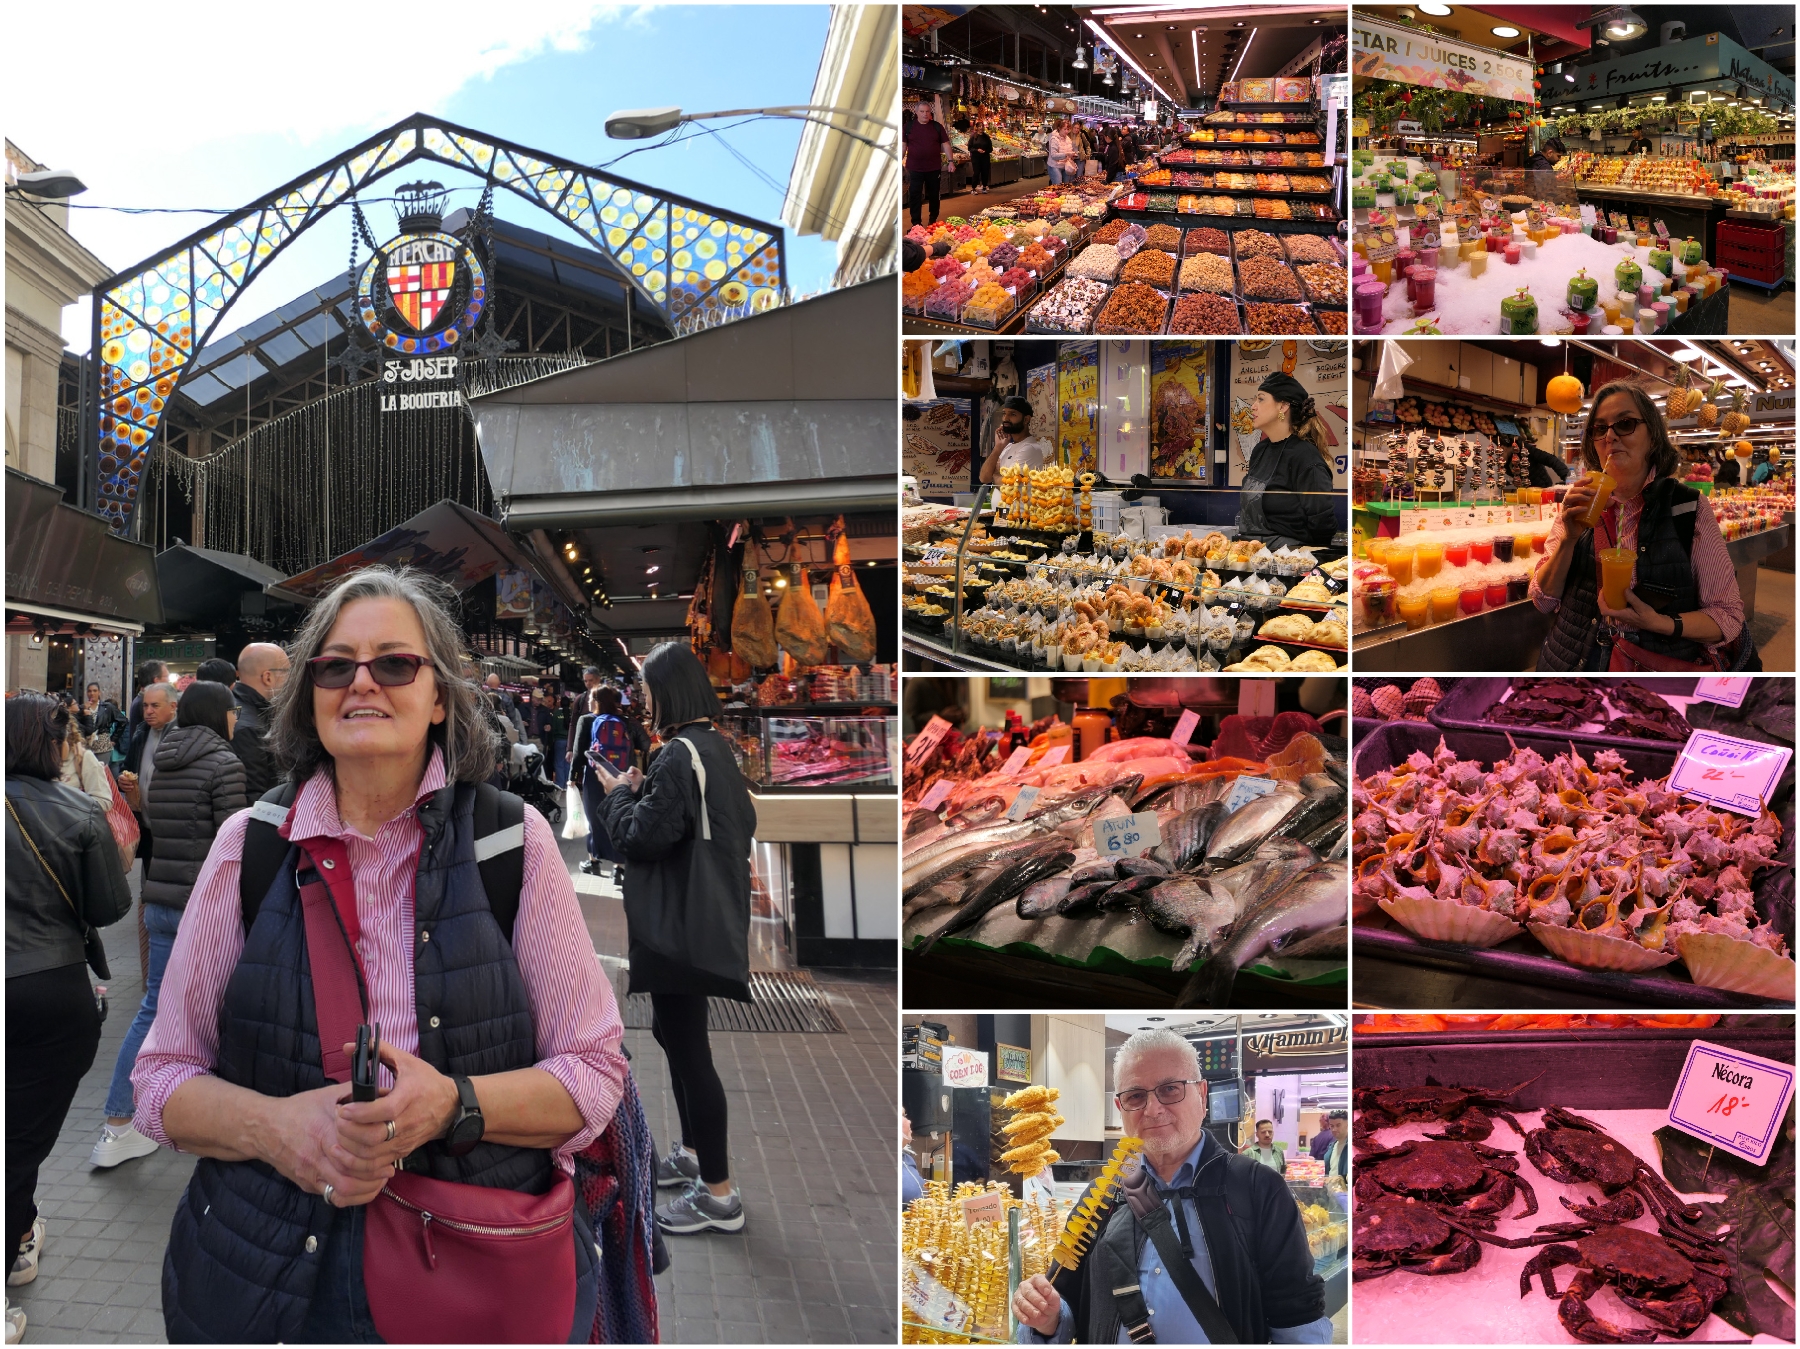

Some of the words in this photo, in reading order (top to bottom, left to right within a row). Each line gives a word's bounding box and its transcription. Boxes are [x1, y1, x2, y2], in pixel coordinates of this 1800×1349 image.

[1417, 45, 1477, 71] JUICES
[389, 240, 455, 267] MERCAT
[400, 355, 458, 382] JOSEP
[1240, 364, 1269, 374] ANELLES
[1317, 371, 1346, 381] FREGIT
[380, 395, 398, 412] LA
[399, 390, 462, 410] BOQUERIA
[136, 643, 205, 660] FRUITES
[1247, 1030, 1324, 1055] Vitamin
[949, 1067, 968, 1080] CORN
[1711, 1062, 1753, 1090] Nécora
